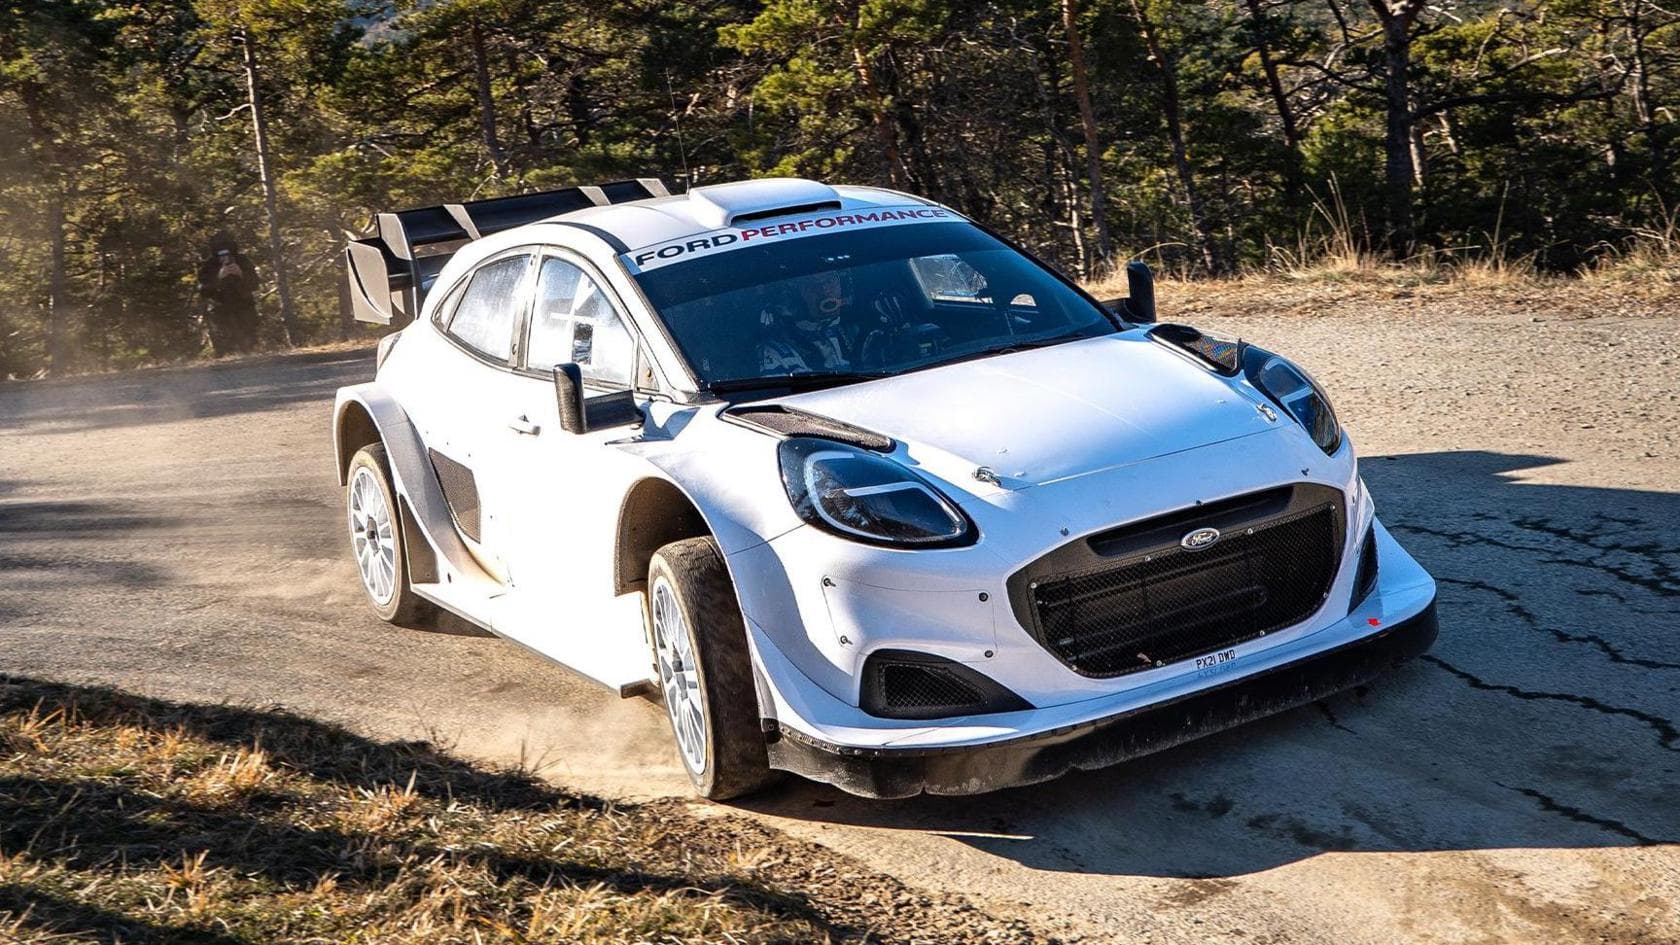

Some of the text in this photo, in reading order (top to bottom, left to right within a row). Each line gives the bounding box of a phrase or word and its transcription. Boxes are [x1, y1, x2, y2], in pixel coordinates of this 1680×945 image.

[635, 209, 949, 266] FORD PERFORMANCE
[1195, 655, 1217, 669] PX21
[1218, 649, 1236, 663] DWD
